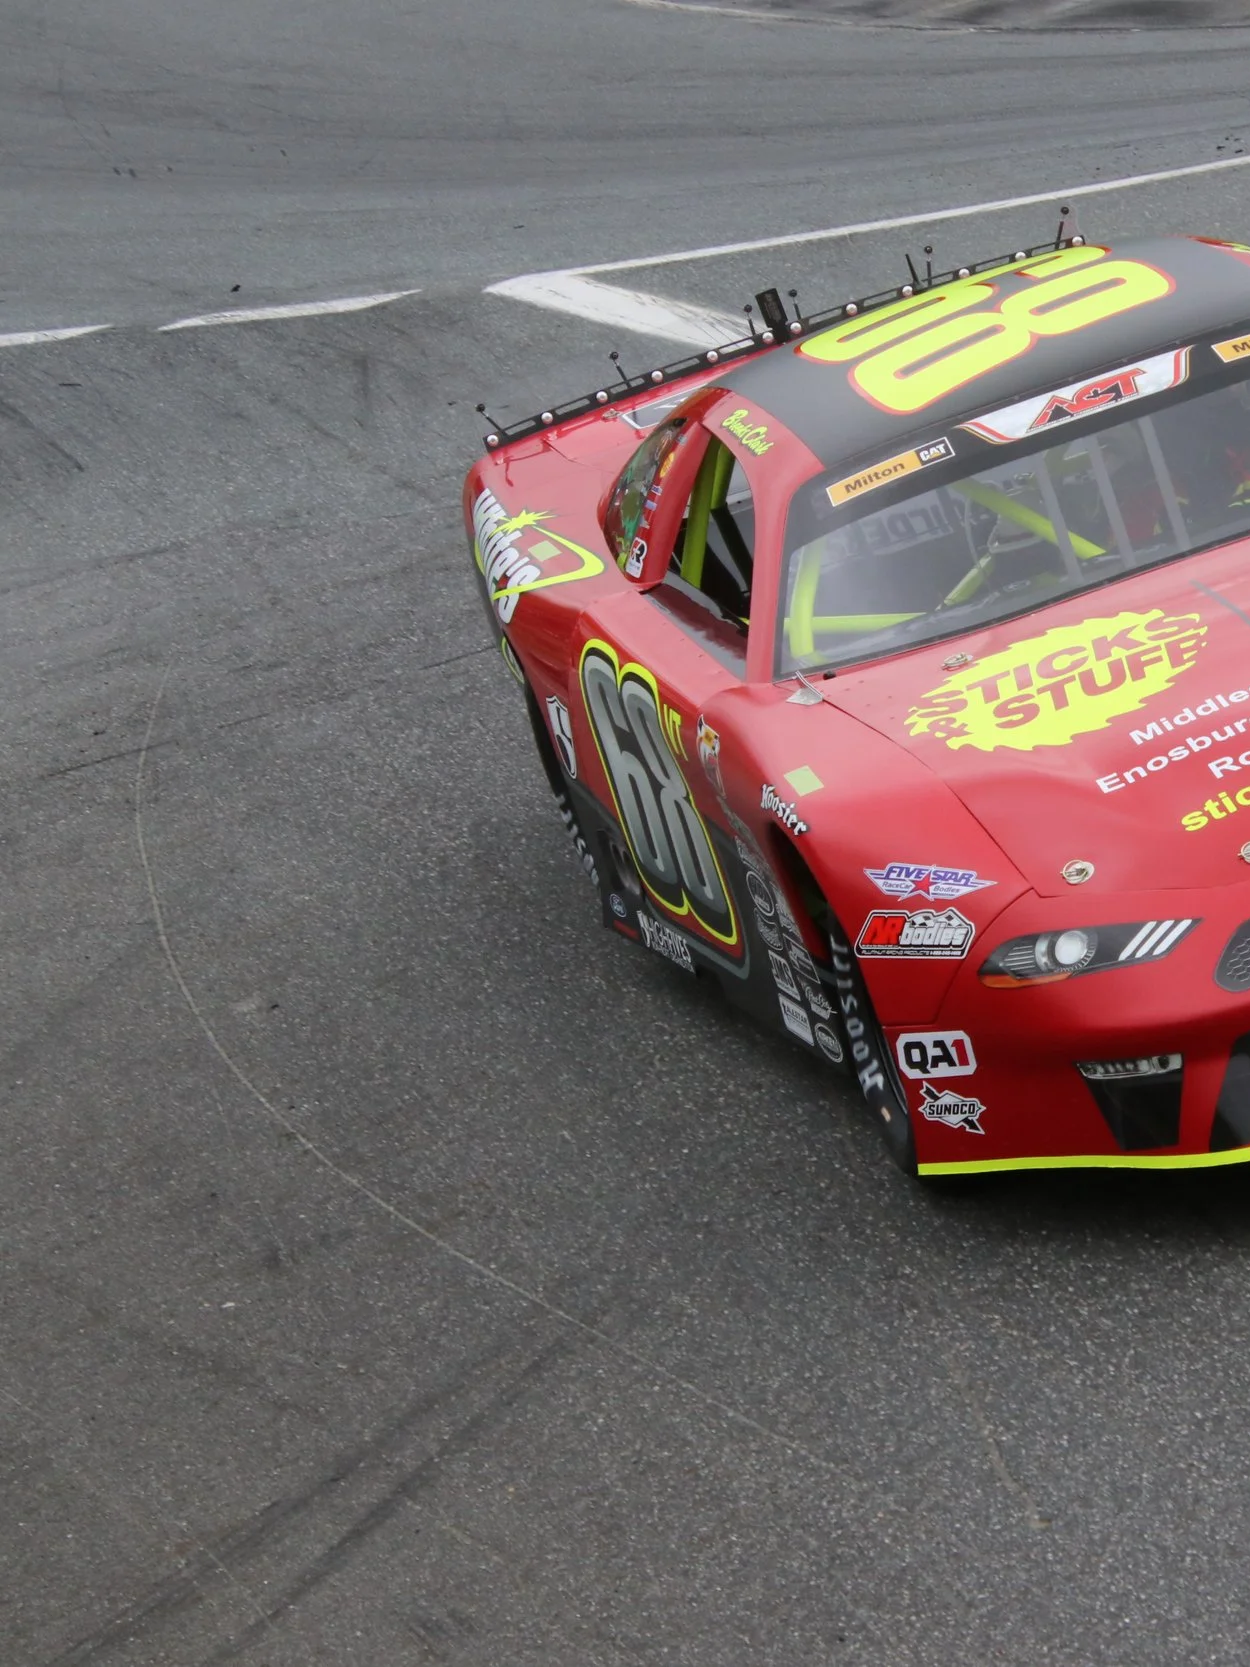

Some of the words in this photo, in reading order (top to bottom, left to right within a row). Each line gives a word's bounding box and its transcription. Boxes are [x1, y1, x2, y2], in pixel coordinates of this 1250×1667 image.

[1028, 368, 1146, 429] ACT
[844, 462, 905, 494] Milton
[919, 443, 946, 462] CAT
[914, 614, 1201, 719] STICKS
[993, 631, 1209, 729] STUFF
[582, 648, 732, 925] 68
[761, 783, 808, 836] Hoosier
[884, 865, 929, 880] FIVE
[931, 869, 974, 886] STAR
[933, 885, 960, 894] Bodies
[903, 1038, 970, 1074] QA1
[928, 1102, 976, 1116] SUNOCO
